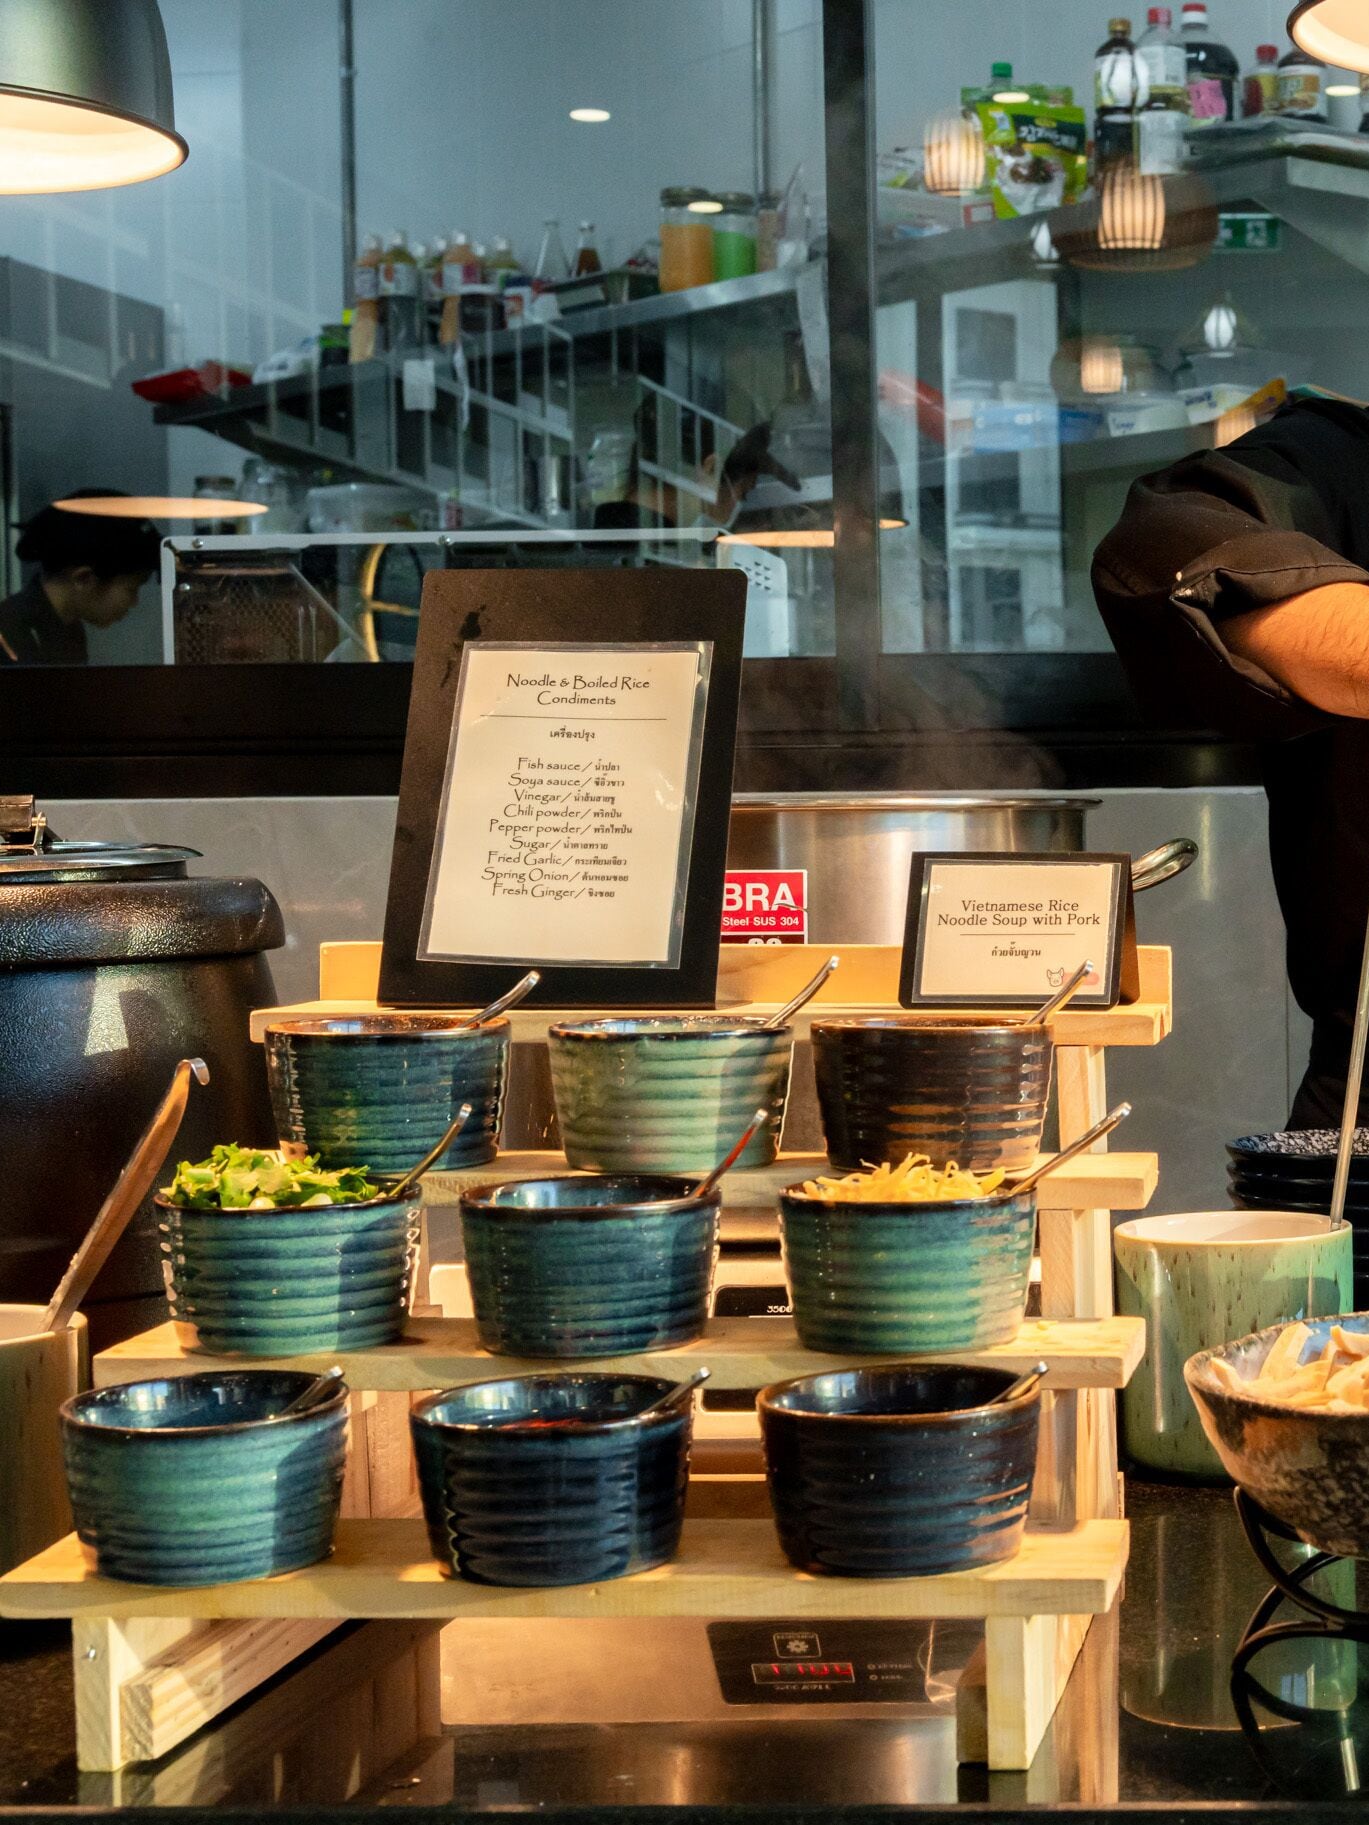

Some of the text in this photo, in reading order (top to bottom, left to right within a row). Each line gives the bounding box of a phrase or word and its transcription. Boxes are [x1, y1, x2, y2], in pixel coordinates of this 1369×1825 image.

[506, 673, 650, 690] Noodle & Boiled Rice
[537, 690, 616, 706] Condiments
[517, 757, 544, 771] Fish
[507, 773, 543, 789] Soya
[503, 804, 534, 818] Chili
[489, 818, 534, 836] Pepper
[487, 851, 521, 864] Fried
[481, 867, 526, 883] Spring
[492, 883, 528, 896] Fresh
[962, 899, 1079, 912] Vietnamese Rice
[722, 916, 799, 926] Steel SUS 304
[938, 913, 1101, 927] Noodle Soup with Pork
